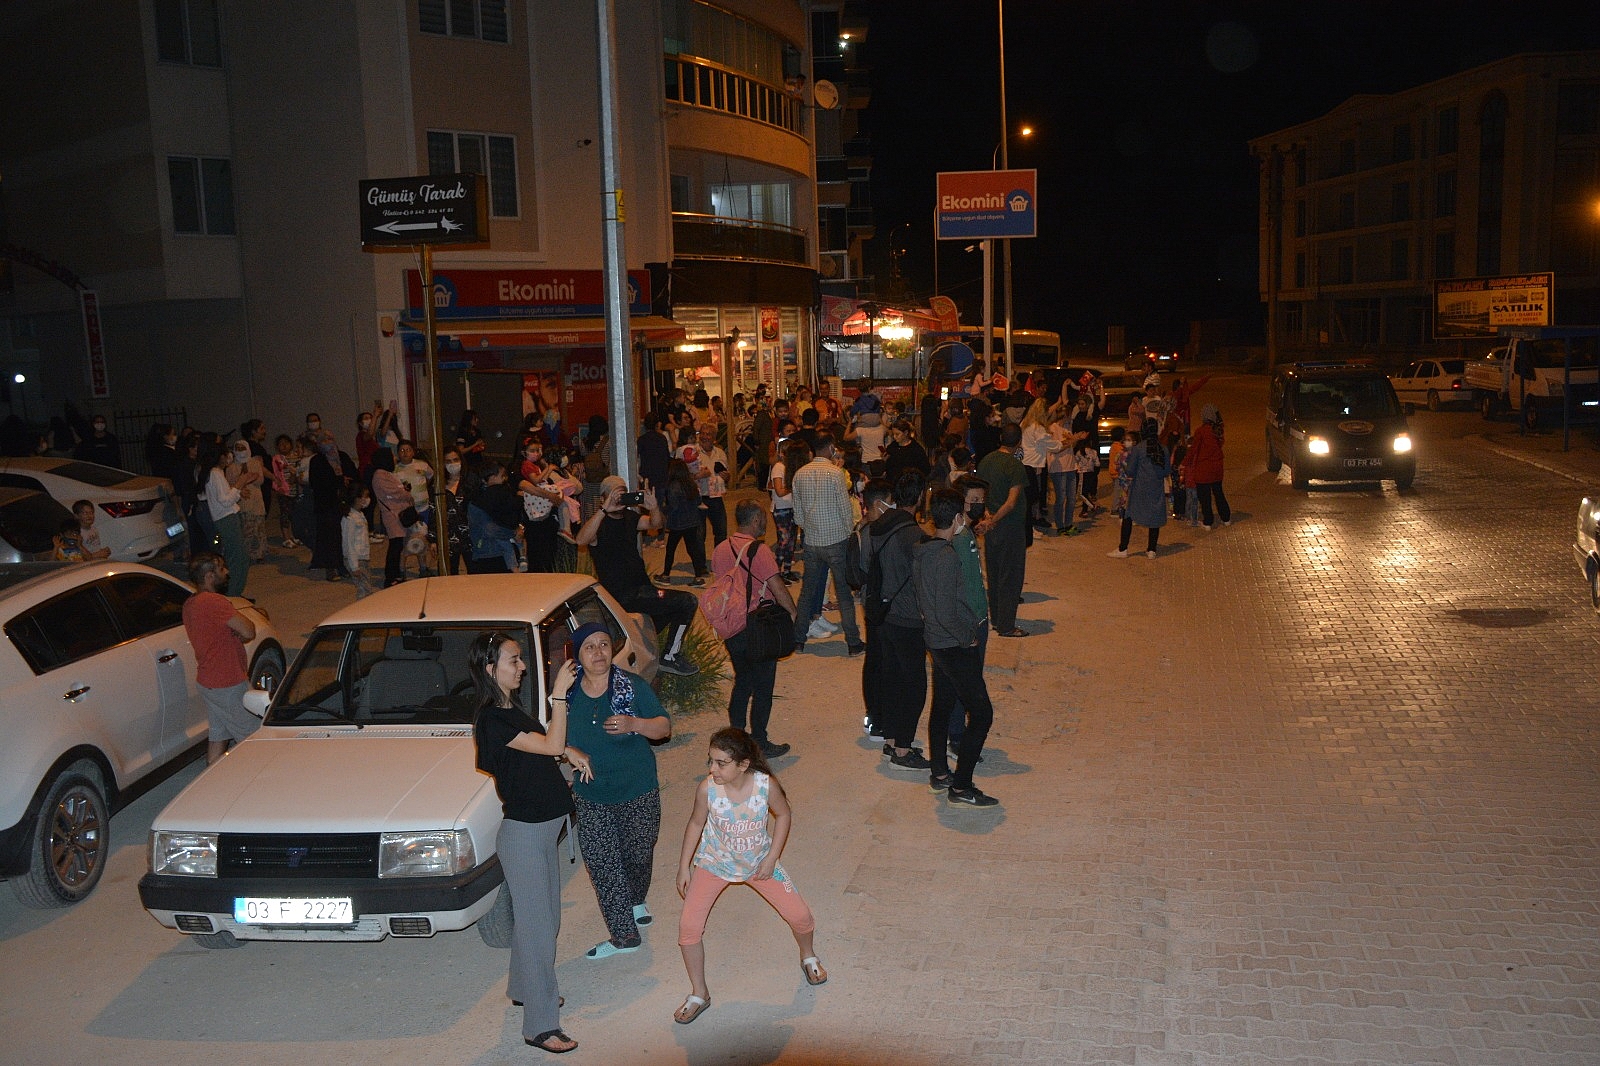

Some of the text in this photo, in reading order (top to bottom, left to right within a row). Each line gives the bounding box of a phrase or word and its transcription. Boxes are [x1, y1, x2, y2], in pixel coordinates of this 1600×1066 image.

[367, 181, 467, 206] Gümüş Tarak
[942, 192, 1004, 210] Ekomini
[498, 278, 575, 301] Ekomini
[1492, 303, 1544, 313] SATILIK
[548, 333, 579, 344] Ekomini
[247, 901, 349, 920] 03 F 2227
